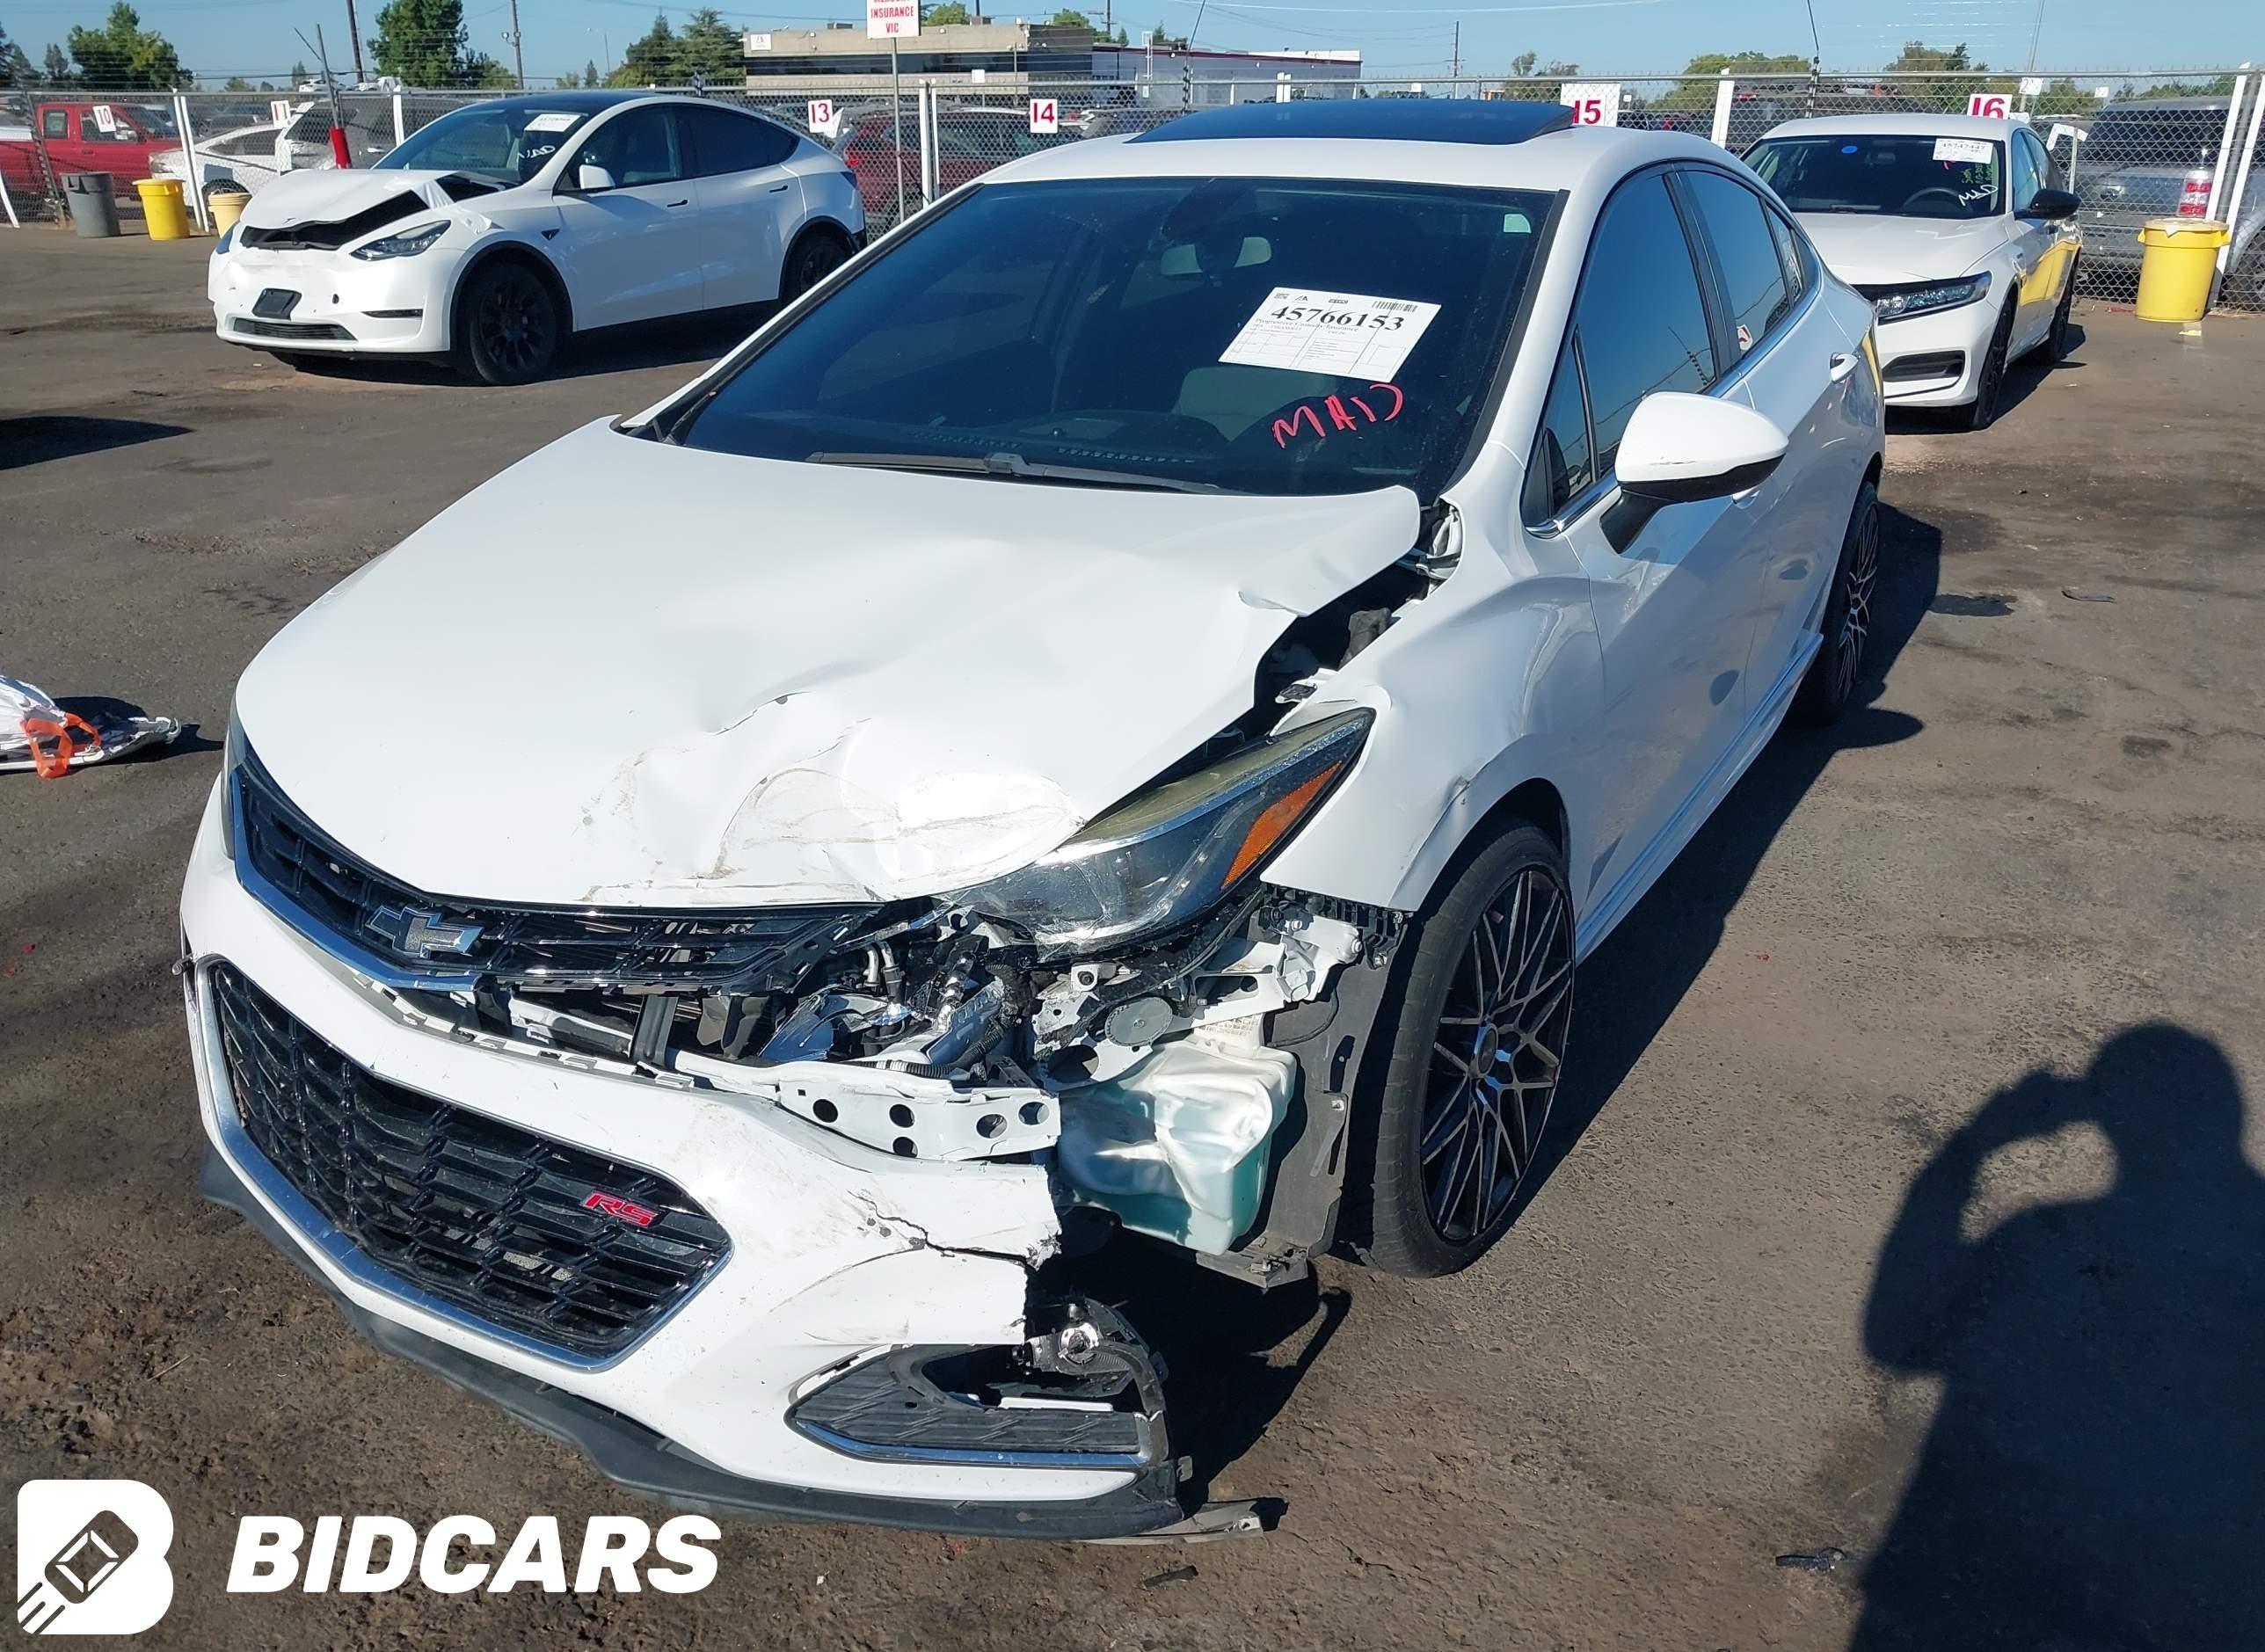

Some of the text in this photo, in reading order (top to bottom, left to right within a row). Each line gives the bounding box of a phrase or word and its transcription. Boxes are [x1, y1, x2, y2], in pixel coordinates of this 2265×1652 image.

[870, 6, 914, 18] INSURANCE
[885, 23, 899, 33] VIC
[98, 107, 112, 125] 10
[811, 103, 830, 123] 13
[1033, 102, 1055, 123] 14
[1572, 99, 1602, 125] 15
[1971, 98, 2006, 120] 16
[1271, 305, 1405, 331] 45766153
[583, 1190, 659, 1228] RS
